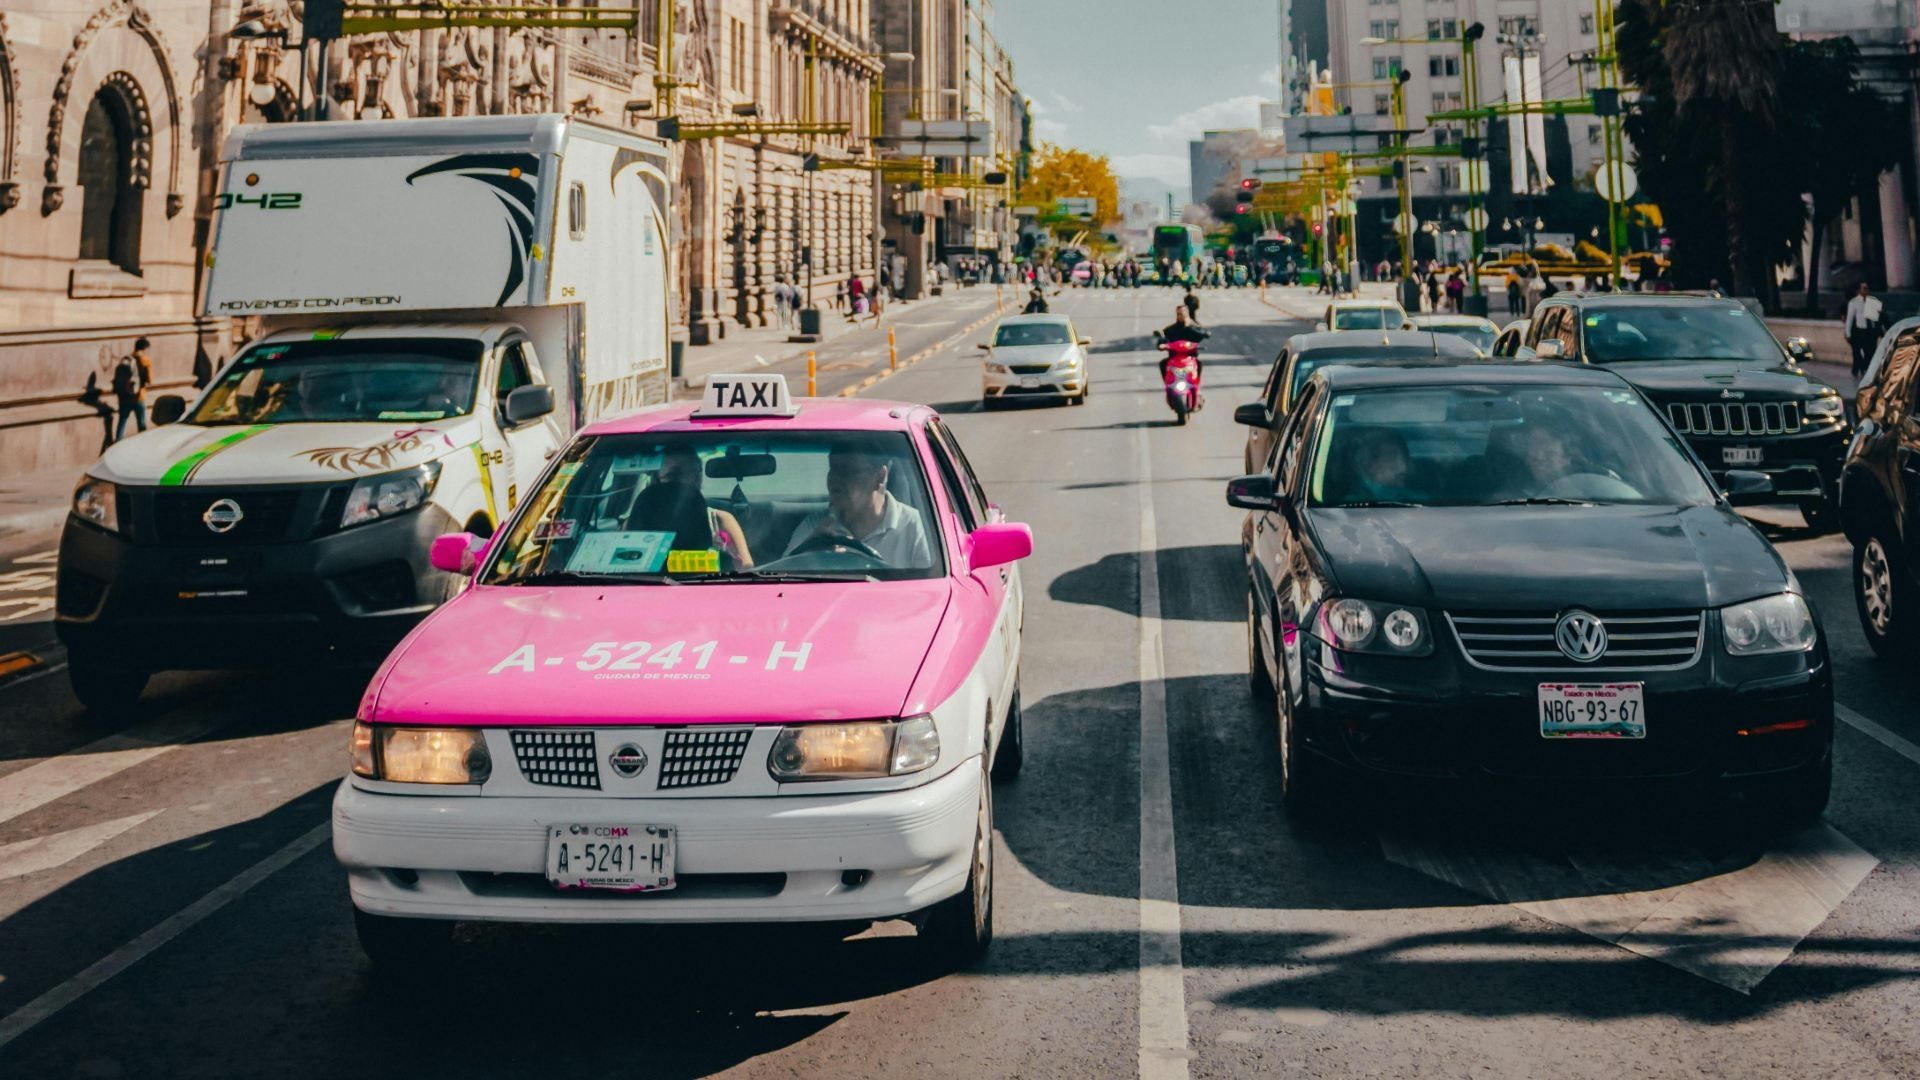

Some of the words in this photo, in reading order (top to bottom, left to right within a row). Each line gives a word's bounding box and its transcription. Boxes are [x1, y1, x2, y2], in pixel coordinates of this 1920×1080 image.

[219, 298, 300, 310] MOVEMOS
[303, 298, 340, 308] CON
[712, 382, 778, 408] TAXI
[593, 672, 641, 681] CIUDAD
[643, 672, 661, 681] DE
[662, 672, 712, 681] MEXICO
[1543, 700, 1638, 722] NBG-93-67
[594, 827, 629, 836] CDMX
[558, 843, 664, 872] A-5241-H
